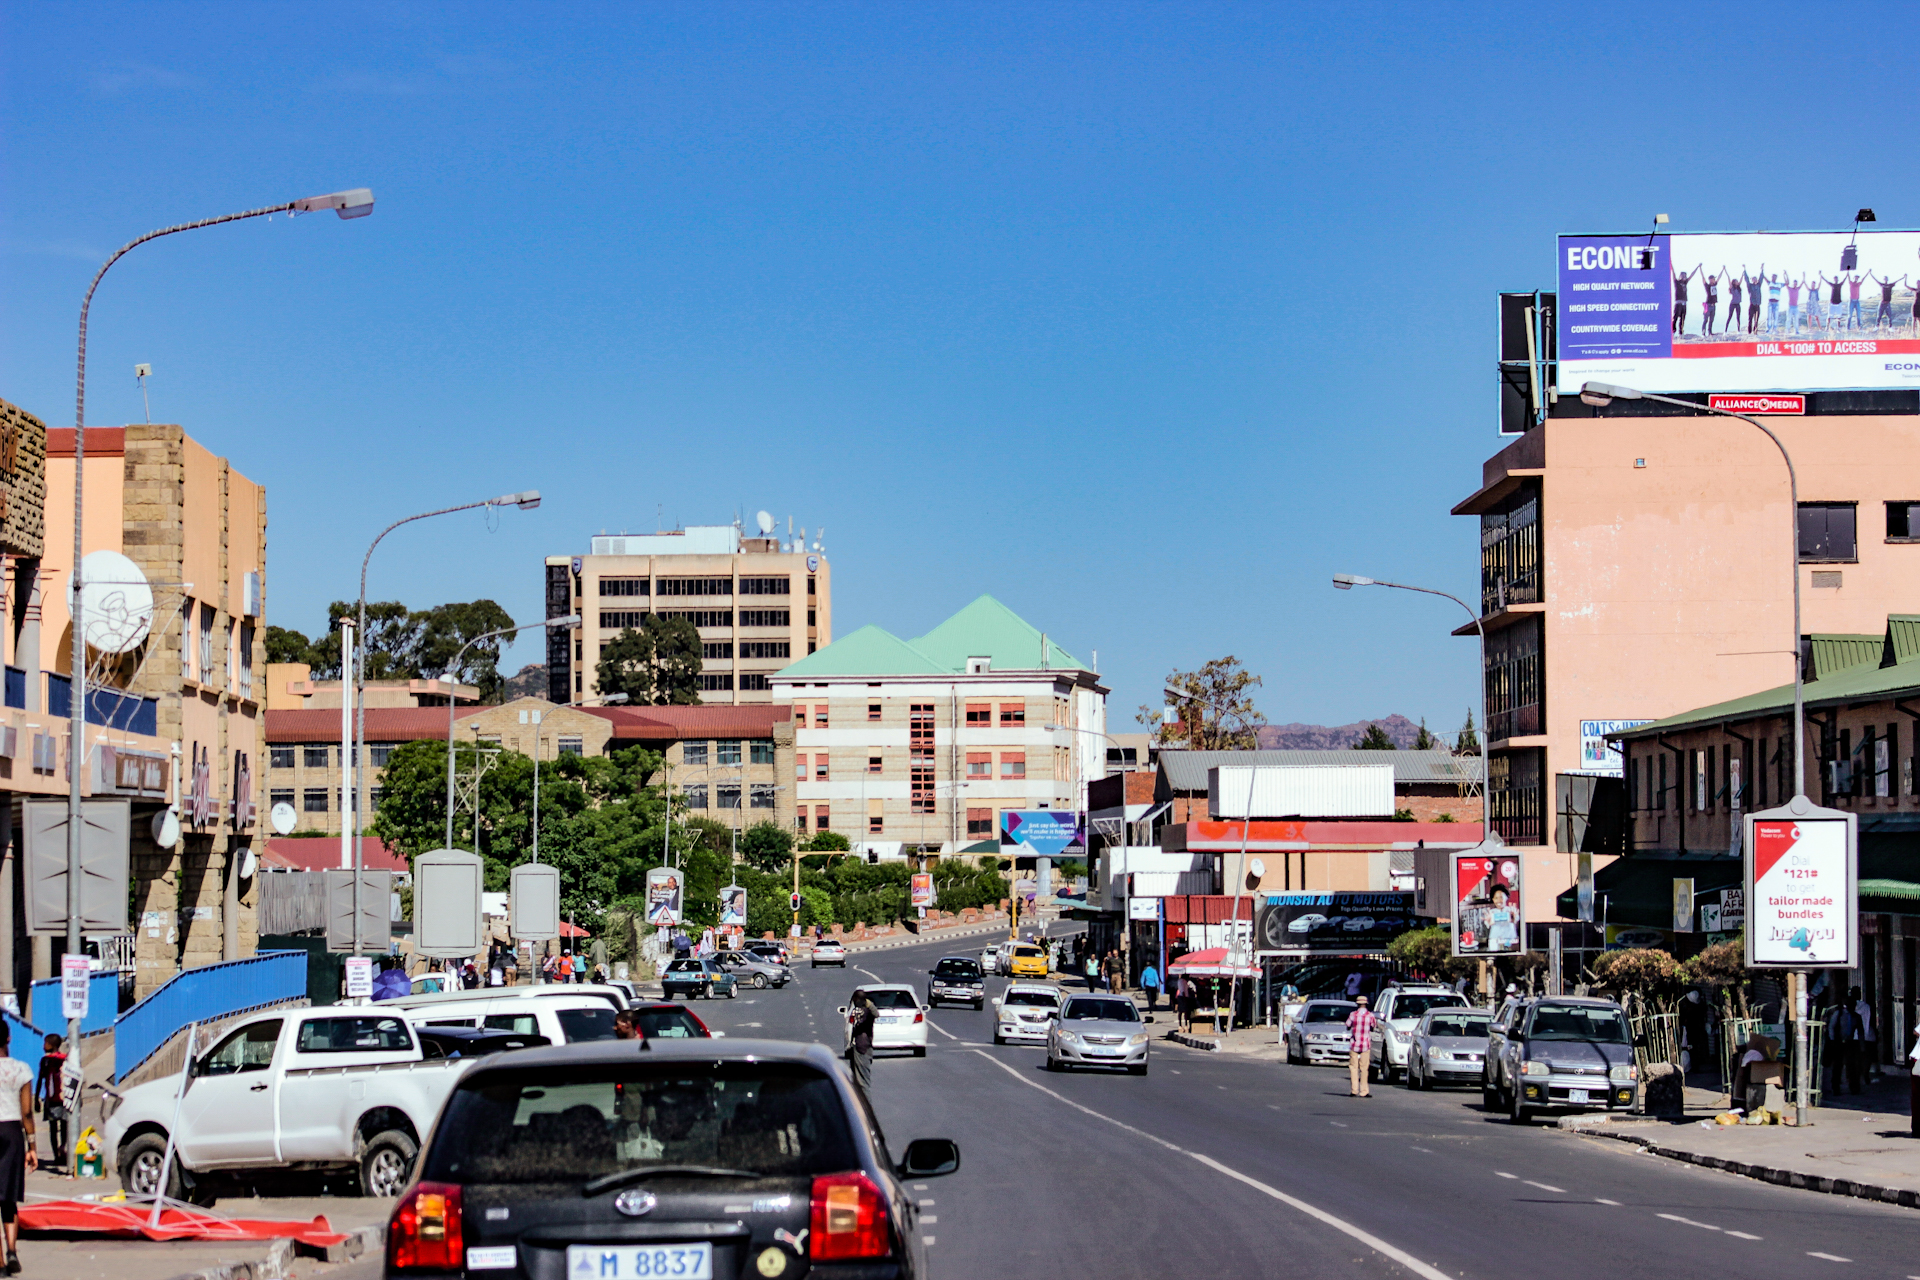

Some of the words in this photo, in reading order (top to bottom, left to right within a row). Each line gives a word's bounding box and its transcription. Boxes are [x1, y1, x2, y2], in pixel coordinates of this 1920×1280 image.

[1567, 245, 1660, 271] ECONET
[1573, 283, 1590, 291] HIGH
[1591, 282, 1620, 291] QUALITY
[1621, 281, 1655, 290] NETWORK
[1569, 304, 1586, 313] HIGH
[1587, 303, 1609, 312] SPEED
[1610, 303, 1660, 311] CONNECTIVITY
[1571, 324, 1620, 334] COUNTRYWIDE
[1621, 324, 1658, 332] COVERAGE
[1756, 343, 1782, 355] DIAL
[1817, 342, 1831, 354] TO
[1834, 341, 1877, 353] ACCESS
[1714, 400, 1759, 409] ALLIANCE
[1768, 400, 1799, 409] MEDIA
[1583, 721, 1615, 737] COATS
[1791, 855, 1810, 866] Dial
[1787, 884, 1796, 893] to
[1799, 884, 1815, 895] get
[1267, 895, 1314, 906] MUNSHI
[1317, 894, 1350, 906] AUTO
[1352, 893, 1404, 906] MOTORS
[1768, 896, 1799, 905] tailor
[1802, 896, 1833, 905] made
[1778, 909, 1824, 919] bundles
[1622, 932, 1658, 944] PEP
[1789, 926, 1812, 952] 4
[601, 1252, 618, 1277] M
[636, 1250, 704, 1276] 8837
